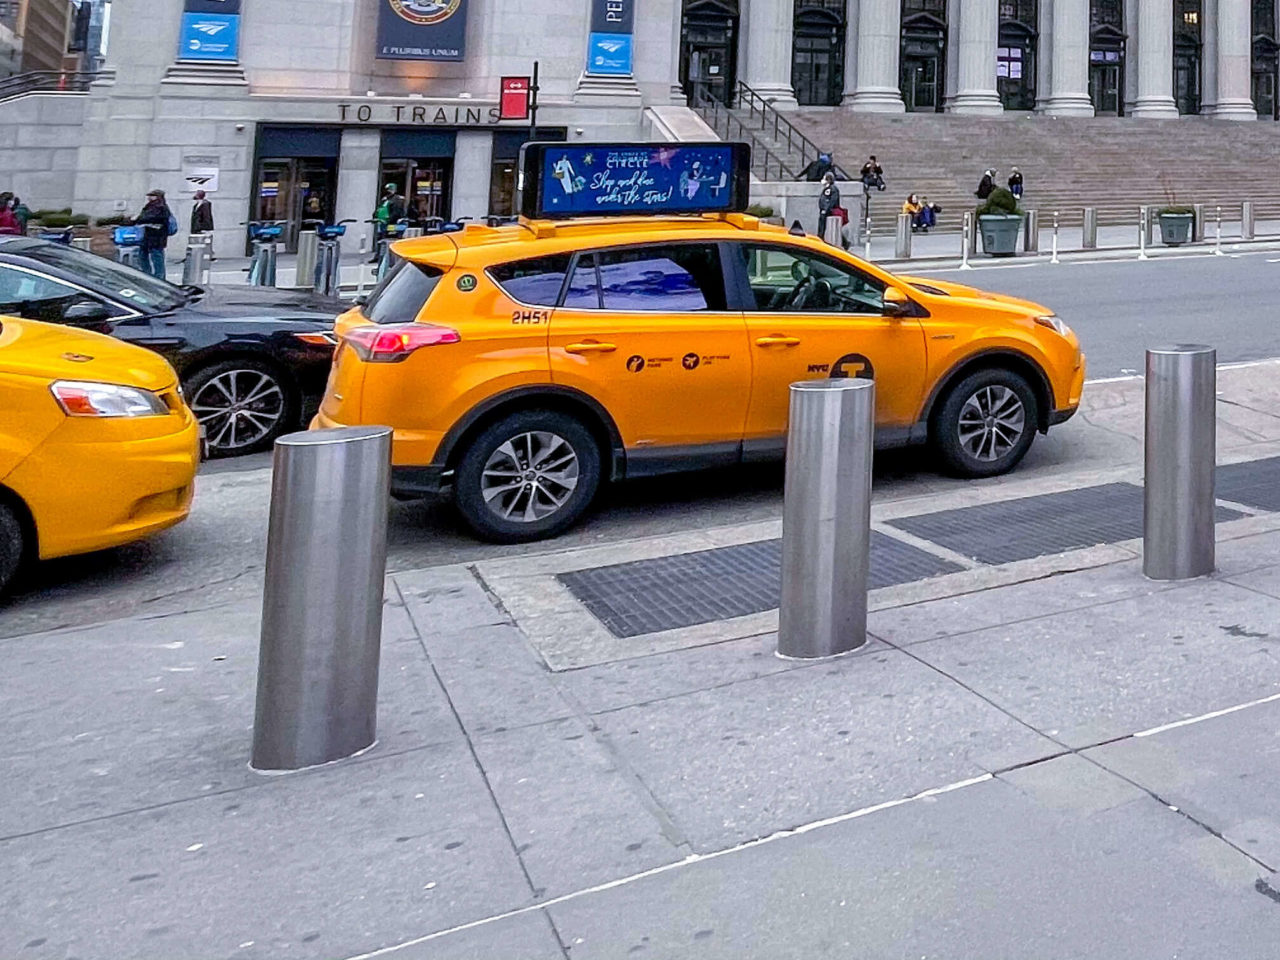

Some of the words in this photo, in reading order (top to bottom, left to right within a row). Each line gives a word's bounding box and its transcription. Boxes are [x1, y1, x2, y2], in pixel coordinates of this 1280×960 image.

[338, 104, 372, 122] TO
[392, 105, 502, 125] TRAINS
[606, 159, 649, 169] CIRCLE
[589, 169, 615, 193] Shop
[618, 170, 639, 188] and
[511, 310, 549, 325] 2H51
[807, 363, 829, 373] NYC
